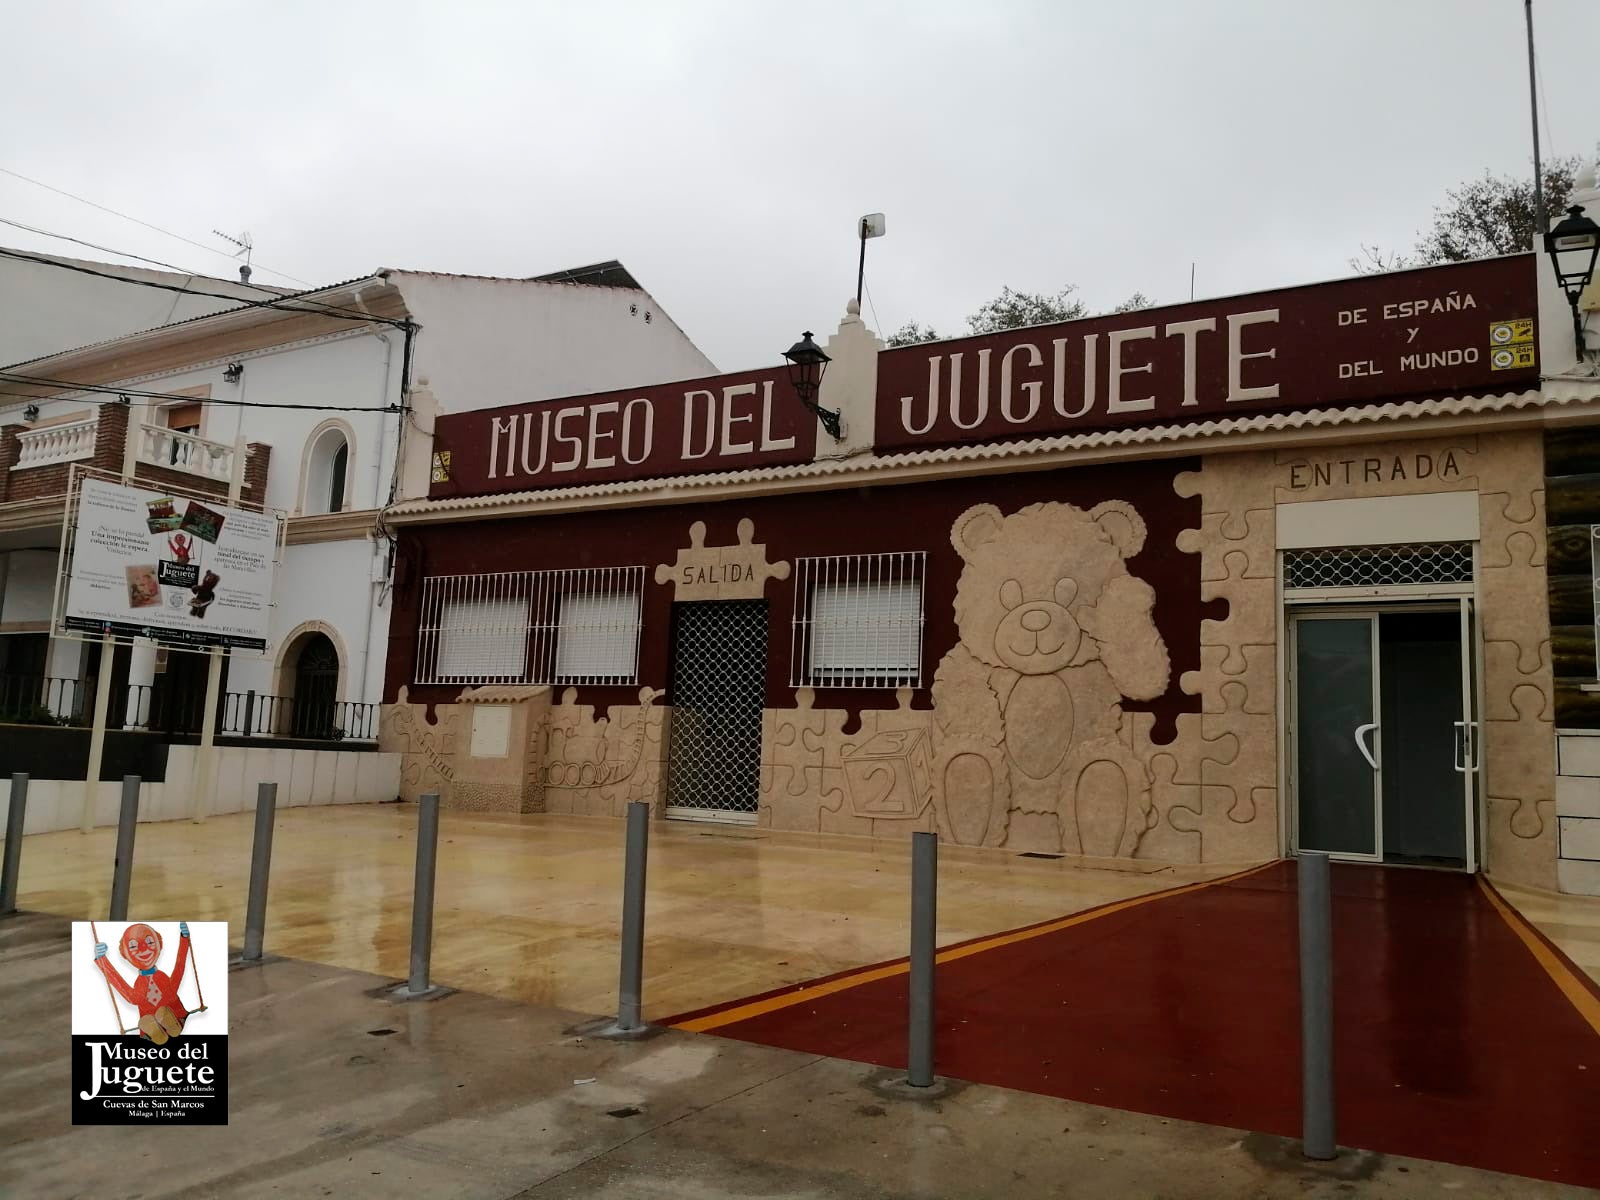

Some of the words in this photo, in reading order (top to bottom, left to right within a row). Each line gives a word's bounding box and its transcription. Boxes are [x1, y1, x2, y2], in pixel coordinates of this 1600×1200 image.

[1338, 308, 1367, 326] DE
[1383, 291, 1477, 320] ESPAÑA
[901, 309, 1280, 435] JUGUETE
[1338, 360, 1383, 379] DEL
[1400, 347, 1479, 372] MUNDO
[488, 398, 654, 479] MUSEO
[681, 380, 795, 461] DEL
[1290, 451, 1460, 489] ENTRADA
[160, 561, 196, 578] Juguete
[682, 564, 754, 585] SALIDA
